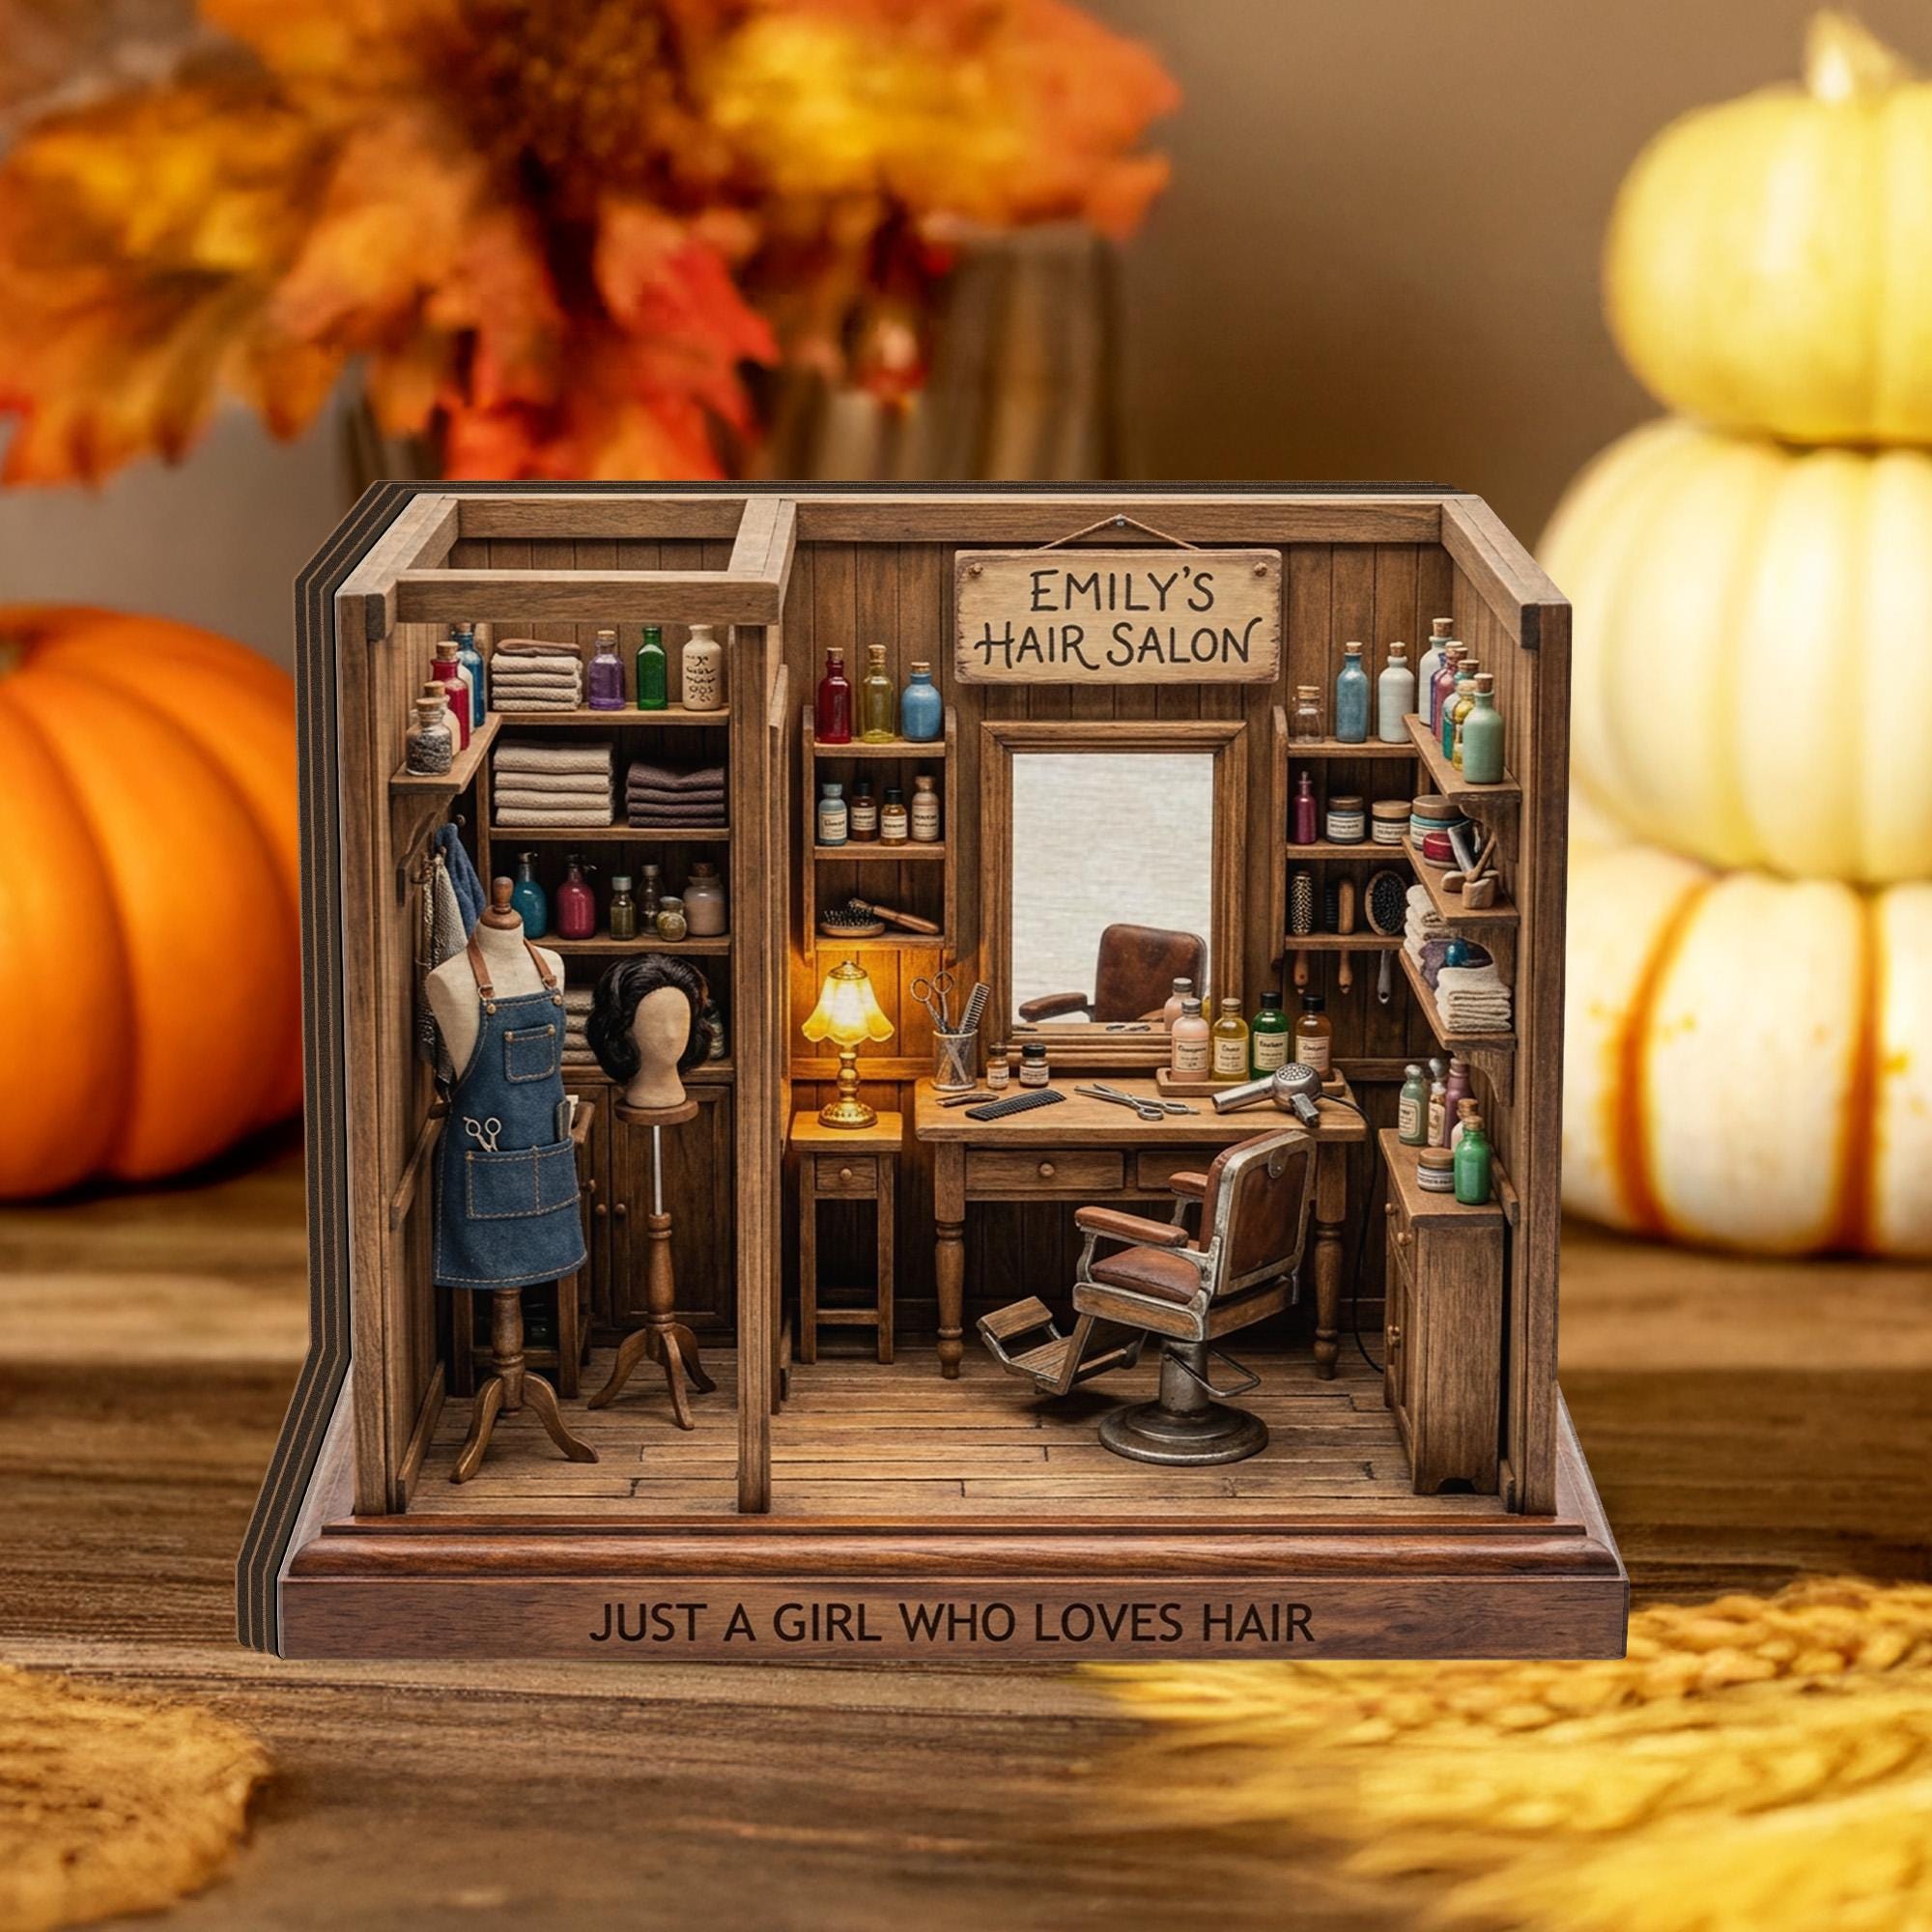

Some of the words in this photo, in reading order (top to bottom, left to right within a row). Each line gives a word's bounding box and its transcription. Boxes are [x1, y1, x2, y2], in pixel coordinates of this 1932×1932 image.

[1030, 565, 1214, 612] EMILY'S
[974, 620, 1100, 669] HAIR
[1107, 616, 1263, 667] SALON
[590, 1603, 708, 1642] JUST
[724, 1603, 756, 1642] A
[773, 1603, 882, 1642] GIRL
[898, 1603, 1015, 1642] WHO
[1036, 1603, 1183, 1642] LOVES
[1203, 1603, 1315, 1642] HAIR
